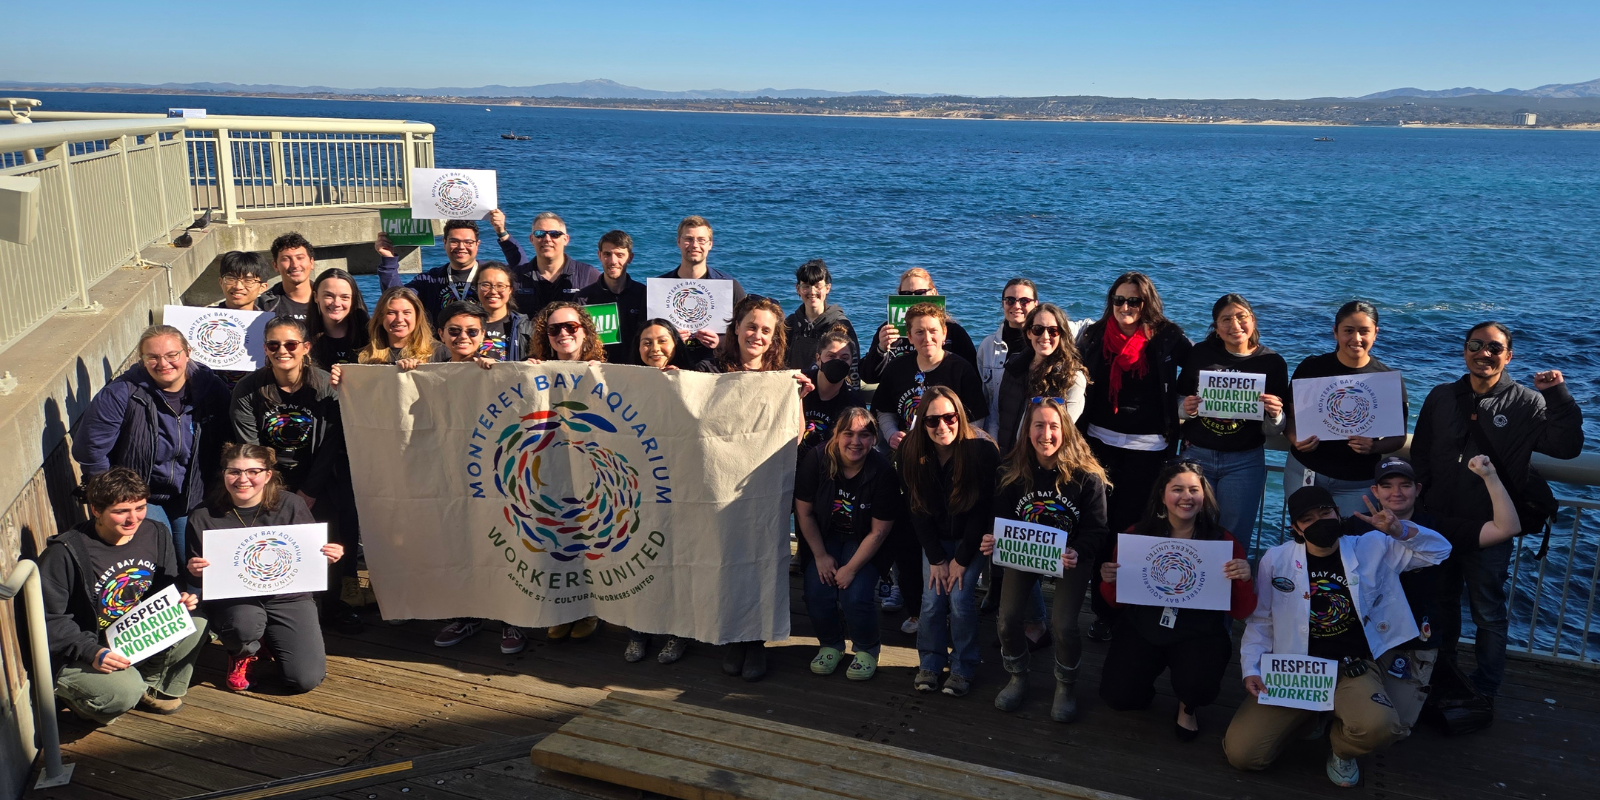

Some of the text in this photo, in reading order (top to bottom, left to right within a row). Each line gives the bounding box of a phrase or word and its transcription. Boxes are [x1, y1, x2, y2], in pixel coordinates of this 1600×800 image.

[431, 173, 448, 198] MONTEREY
[462, 174, 479, 199] AQUARIUM
[434, 202, 458, 216] WORKERS
[460, 203, 477, 215] UNITED
[666, 283, 683, 308] MONTEREY
[698, 284, 715, 310] AQUARIUM
[188, 313, 211, 340] MONTEREY
[669, 314, 693, 328] WORKERS
[694, 314, 712, 328] UNITED
[224, 349, 246, 363] UNITED
[1208, 376, 1257, 390] RESPECT
[1202, 388, 1261, 402] AQUARIUM
[1319, 382, 1338, 413] MONTEREY
[1355, 381, 1378, 409] AQUARIUM
[1205, 400, 1258, 414] WORKERS
[1322, 419, 1353, 434] WORKERS
[1355, 414, 1376, 433] UNITED
[467, 374, 672, 504] MONTEREY BAY AQUARIUM
[1004, 525, 1058, 545] RESPECT
[233, 533, 258, 566] MONTEREY
[278, 532, 301, 562] AQUARIUM
[488, 526, 666, 589] WORKERS UNITED
[997, 538, 1062, 560] AQUARIUM
[1146, 545, 1169, 561] UNITED
[1171, 545, 1202, 564] WORKERS
[117, 559, 135, 569] BAY
[1000, 550, 1057, 572] WORKERS
[238, 573, 272, 588] WORKERS
[274, 569, 298, 587] UNITED
[508, 573, 533, 597] AFSCME
[555, 592, 598, 604] CULTURAL
[597, 590, 630, 602] WORKERS
[632, 574, 655, 594] UNITED
[1142, 567, 1163, 600] AQUARIUM
[1182, 571, 1205, 602] MONTEREY
[115, 595, 171, 634] RESPECT
[113, 603, 184, 648] AQUARIUM
[1325, 617, 1356, 633] UNITED
[120, 617, 186, 657] WORKERS
[1271, 659, 1328, 675] RESPECT
[1265, 673, 1333, 689] AQUARIUM
[1268, 687, 1329, 702] WORKERS
